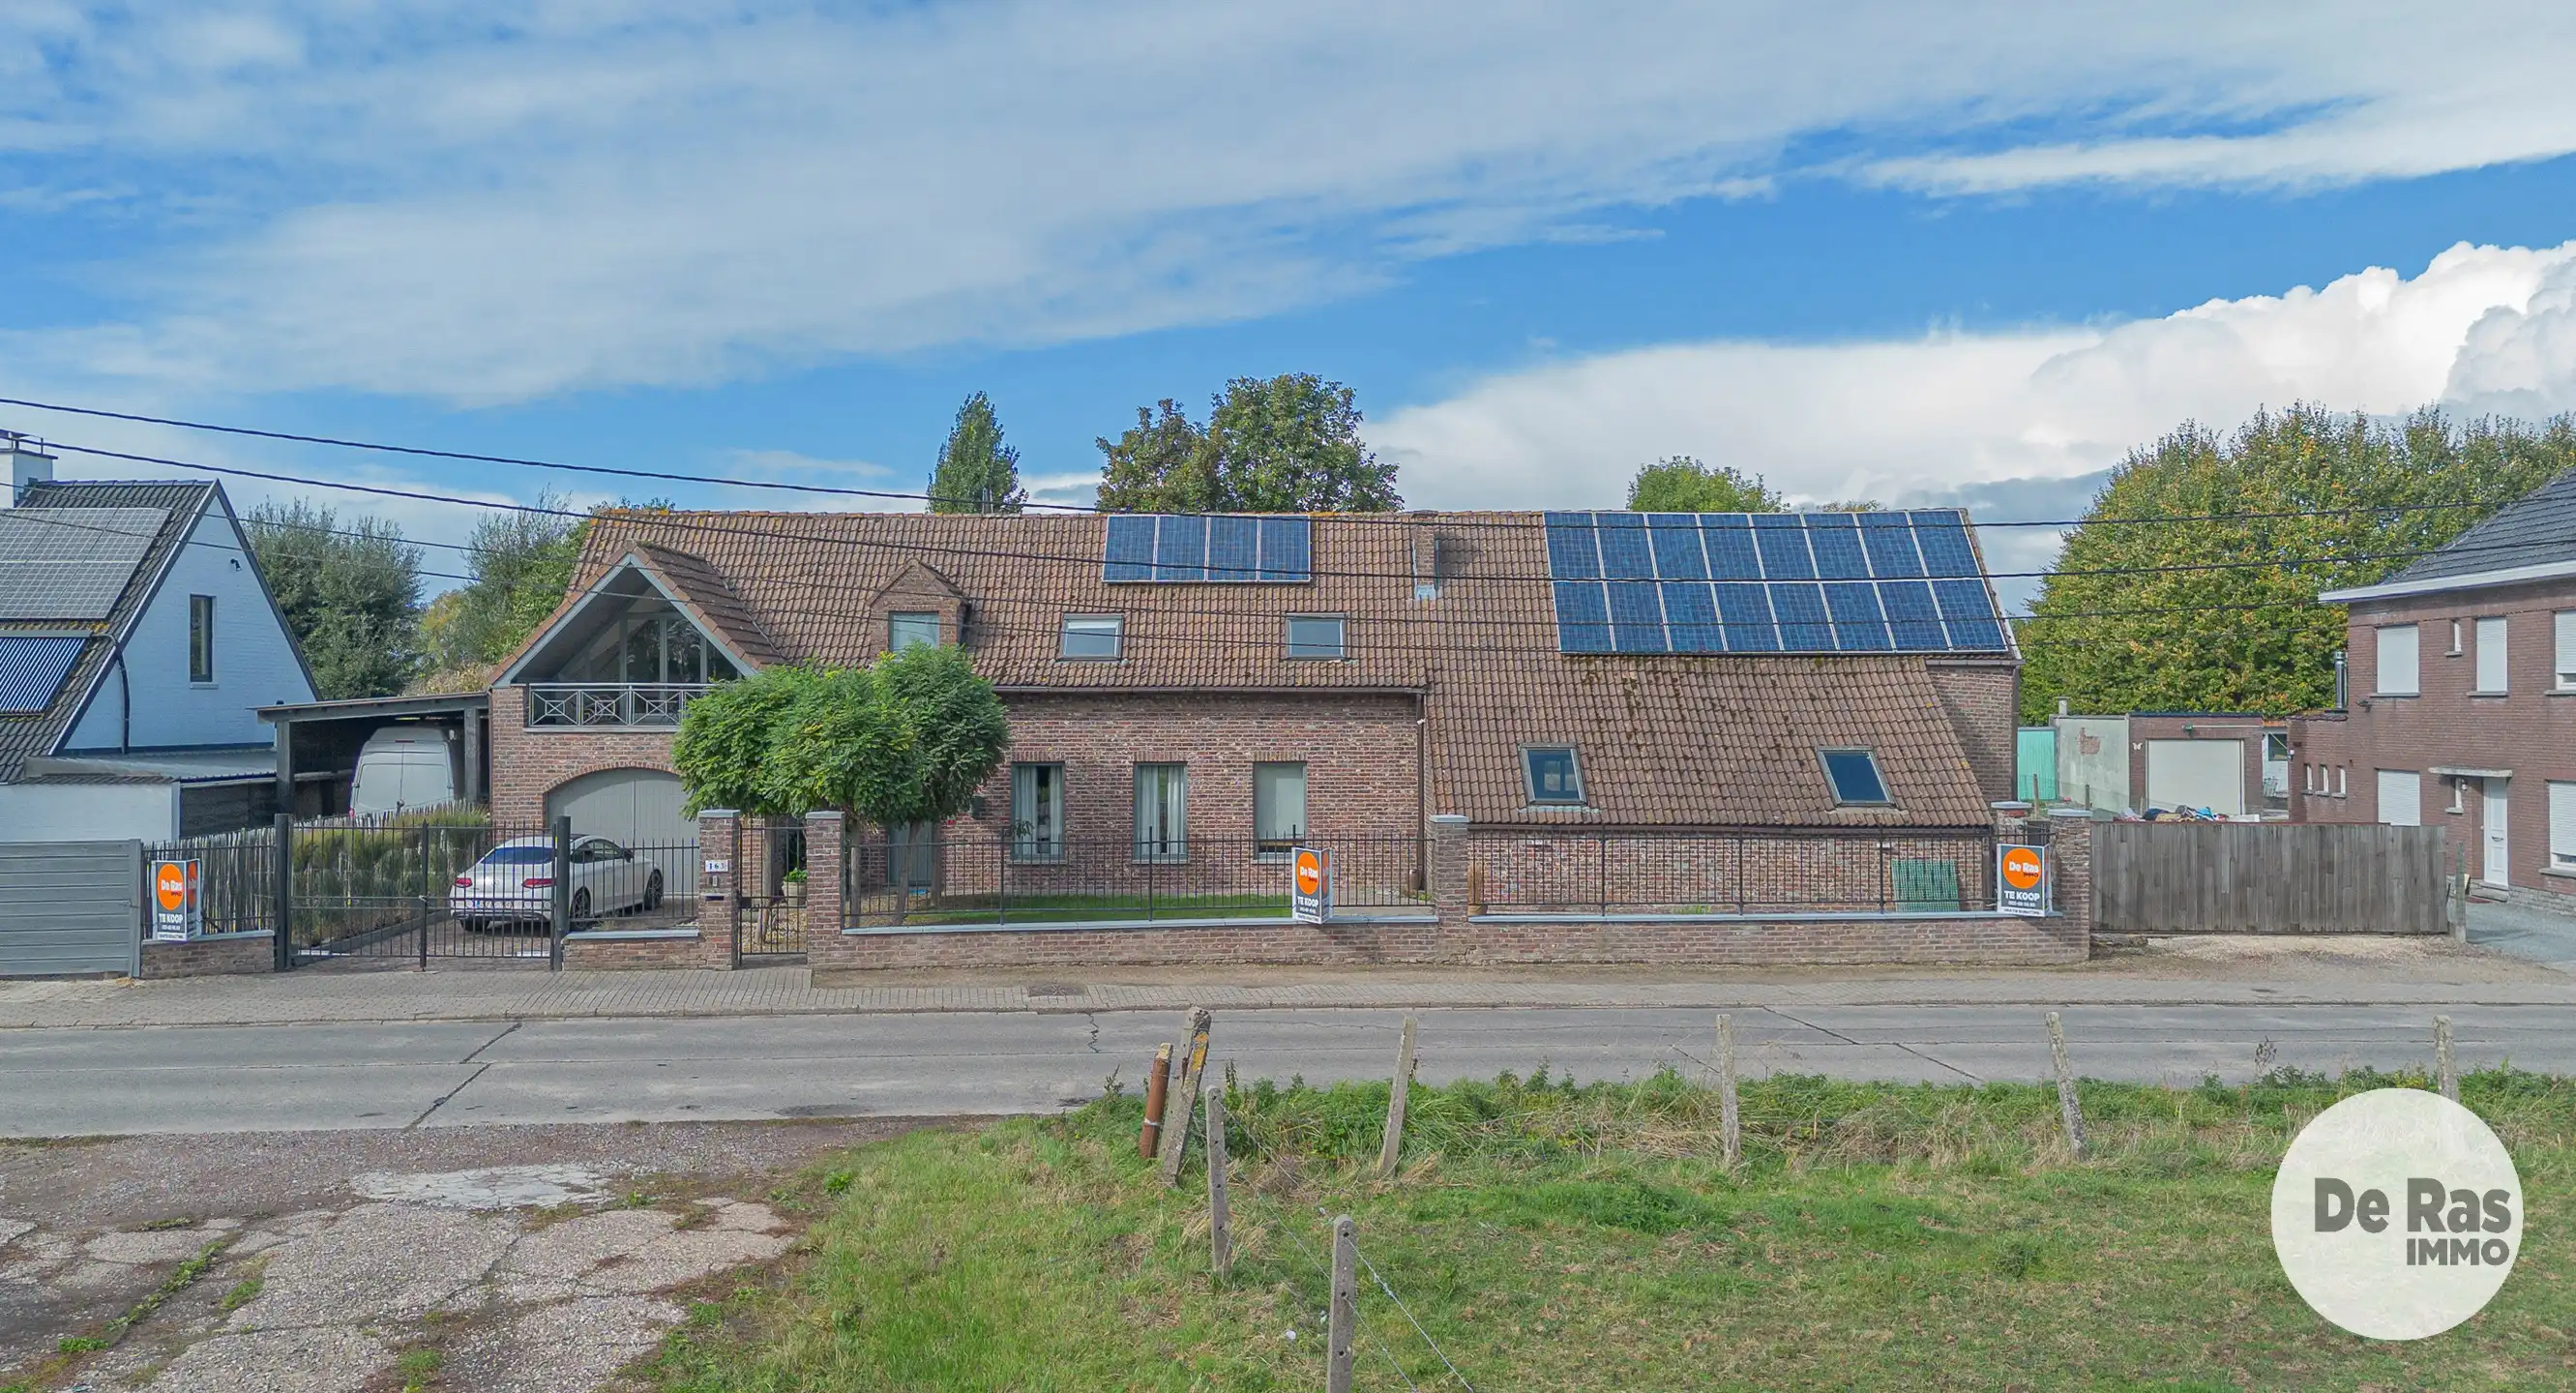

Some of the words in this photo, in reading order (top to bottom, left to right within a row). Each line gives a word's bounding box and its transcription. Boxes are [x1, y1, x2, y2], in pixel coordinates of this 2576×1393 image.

[1299, 866, 1307, 875] De
[2008, 861, 2022, 872] De
[161, 879, 170, 890] De
[1297, 896, 1304, 904] TE
[1304, 897, 1318, 907] KOOP
[2004, 890, 2015, 900] TE
[2016, 891, 2040, 902] KOOP
[159, 913, 166, 922] TE
[166, 913, 184, 924] KOOP
